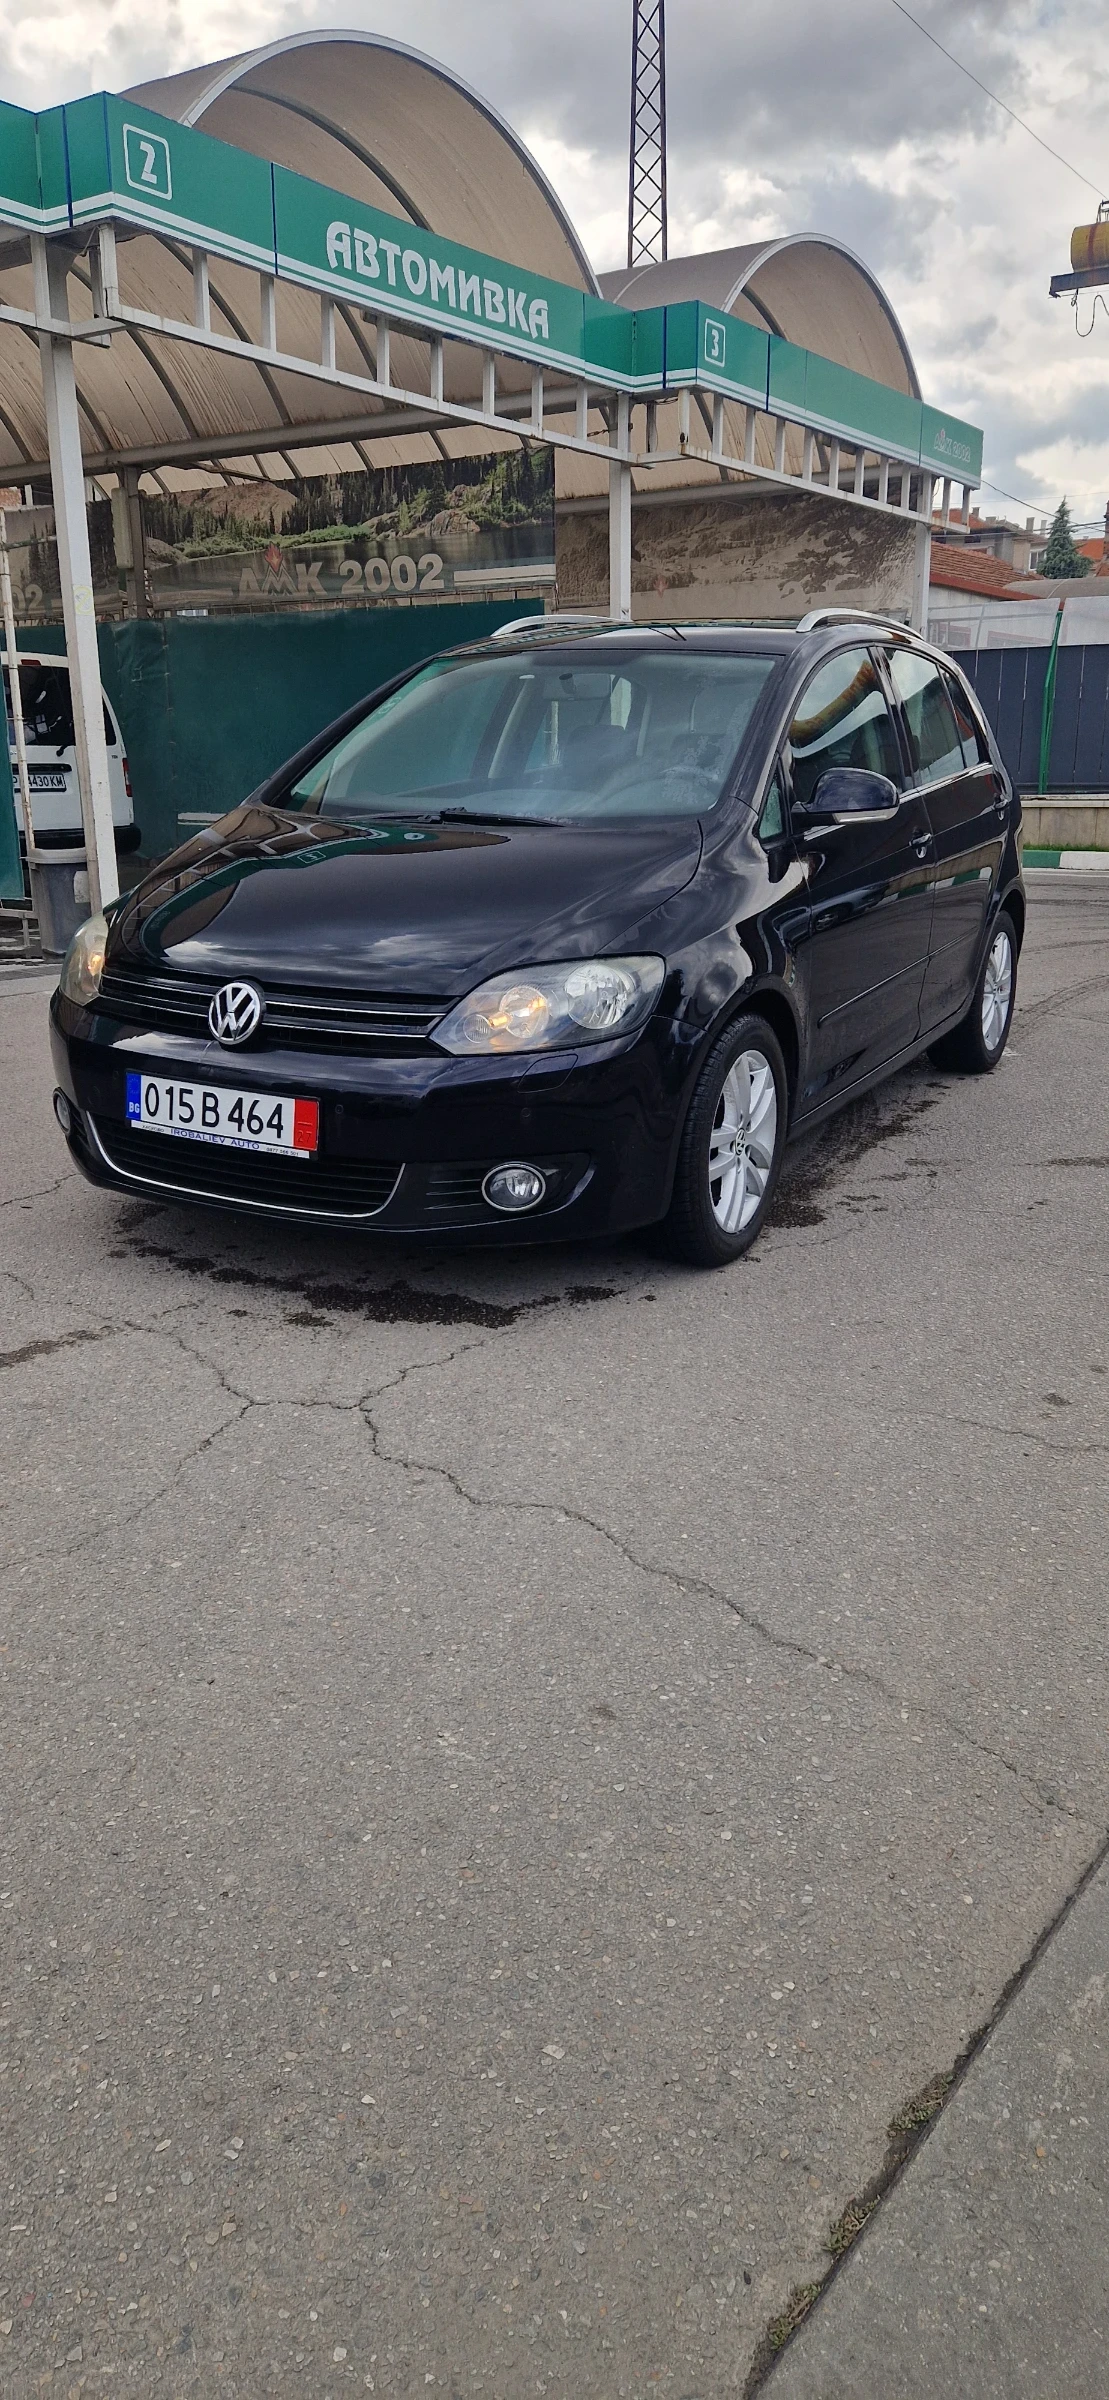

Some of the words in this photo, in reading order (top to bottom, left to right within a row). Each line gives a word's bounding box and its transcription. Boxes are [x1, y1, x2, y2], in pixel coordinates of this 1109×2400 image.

[140, 141, 157, 184] 2
[326, 221, 549, 339] АВТОМИВКА
[711, 329, 719, 357] 3
[953, 441, 970, 463] 2002
[338, 553, 445, 594] 2002
[0, 583, 44, 614] 02
[51, 775, 63, 787] KM
[129, 1101, 140, 1114] BG
[170, 1128, 226, 1144] IROBALIEV
[230, 1138, 260, 1150] AUTO
[297, 1130, 312, 1143] 27
